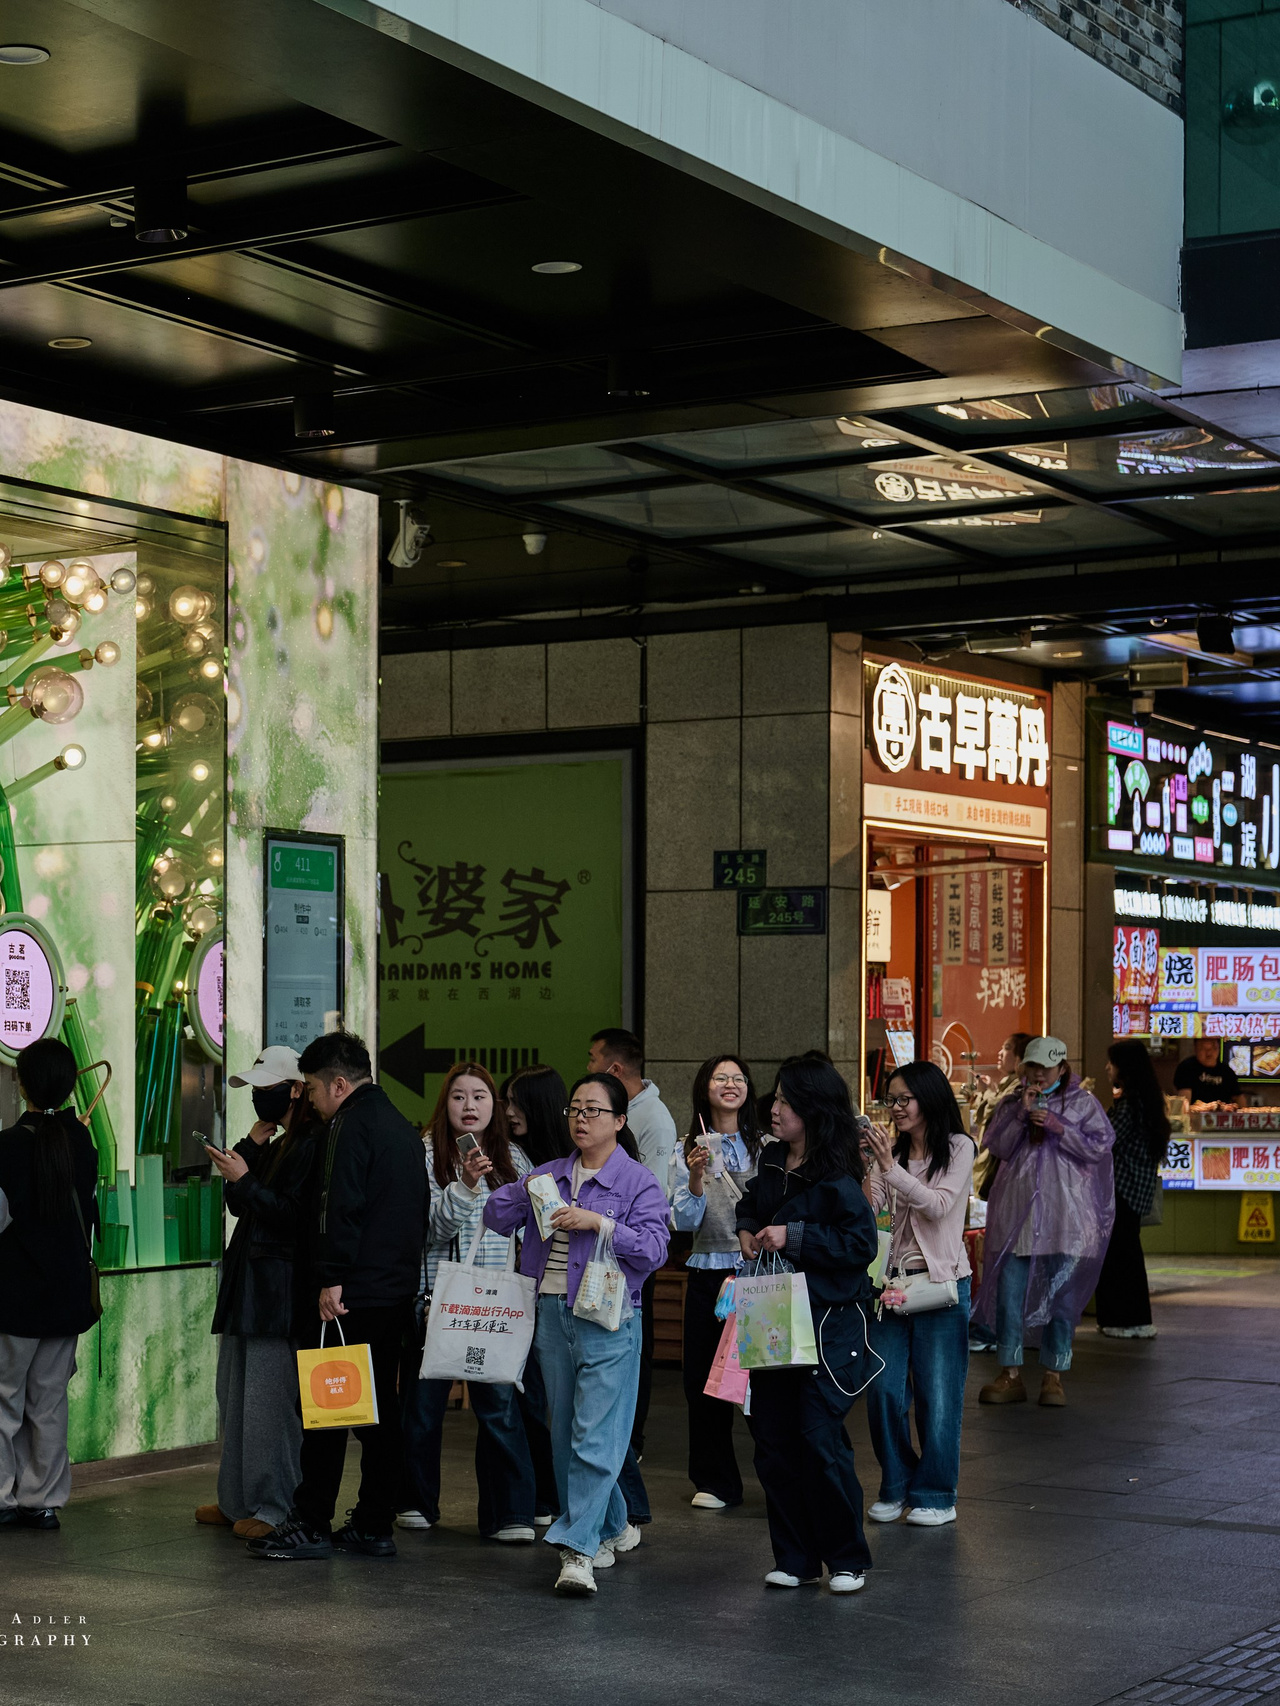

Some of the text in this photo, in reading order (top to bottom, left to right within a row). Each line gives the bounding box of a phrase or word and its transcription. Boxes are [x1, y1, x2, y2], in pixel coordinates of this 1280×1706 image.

[918, 684, 1049, 787] 古早萬丹
[723, 868, 756, 884] 245
[748, 895, 814, 909] 延安路
[769, 911, 804, 923] 245号
[8, 943, 25, 955] 古茗
[490, 961, 552, 980] HOME
[1165, 954, 1194, 985] 烧
[1206, 954, 1280, 981] 肥肠包
[387, 986, 553, 1000] 家就在西湖边
[4, 1020, 32, 1032] 扫码下单
[1207, 1013, 1280, 1036] 武汉热干
[743, 1284, 787, 1295] MOLLY TEA
[440, 1303, 524, 1319] 下载滴滴出行App
[449, 1318, 509, 1333] 打车更便宜
